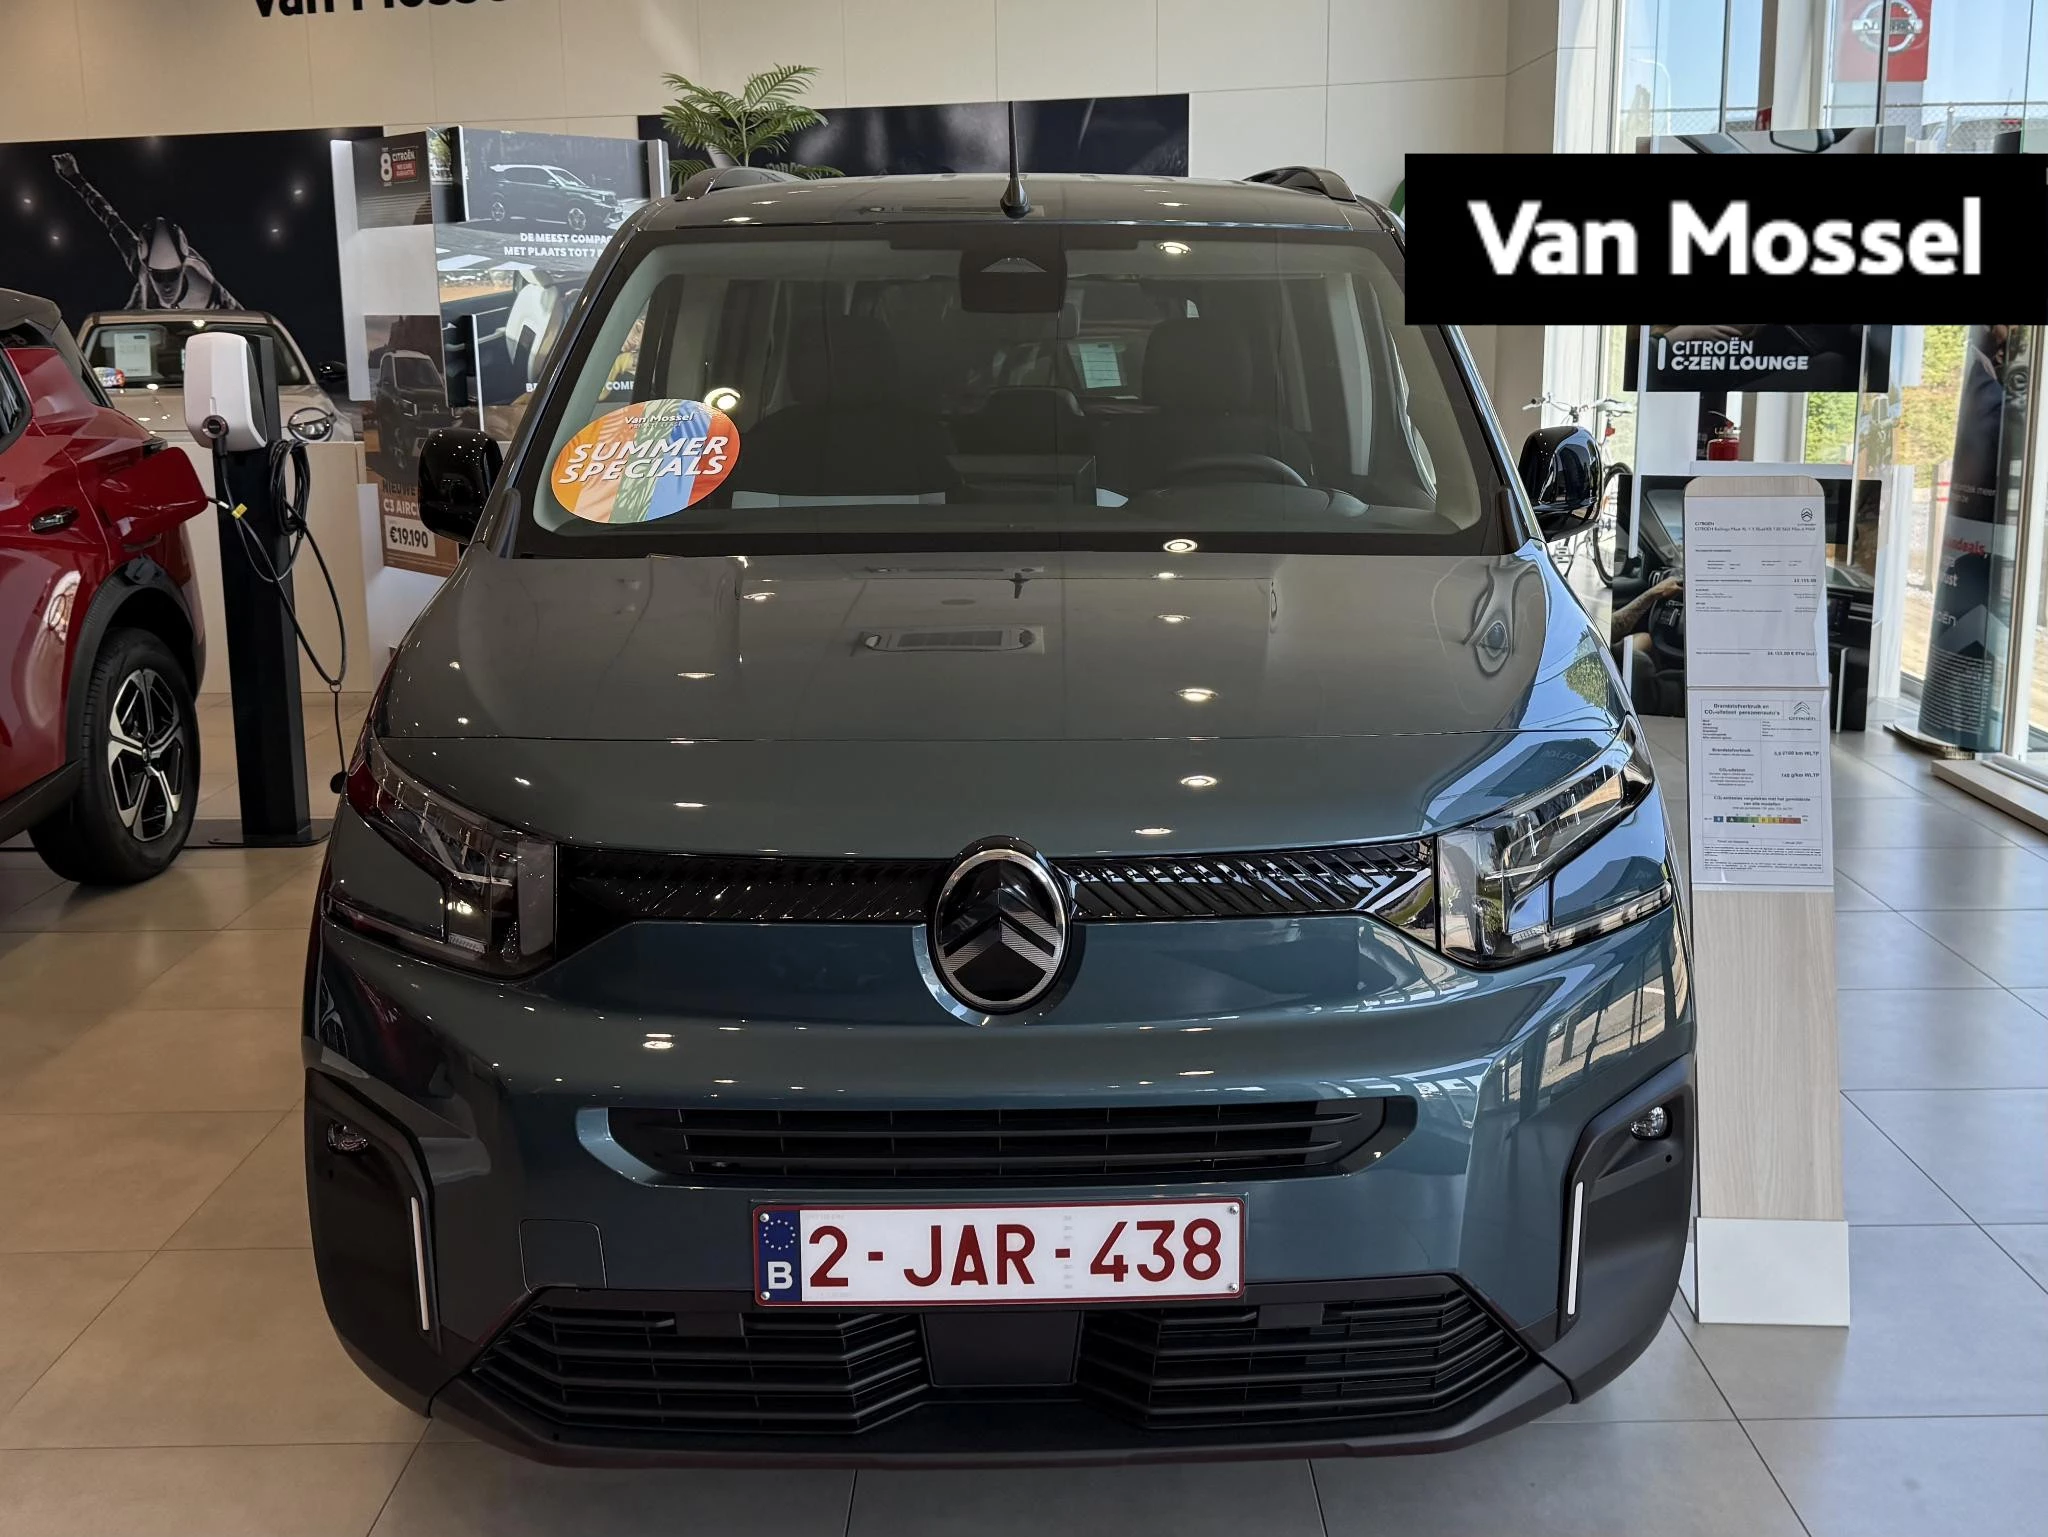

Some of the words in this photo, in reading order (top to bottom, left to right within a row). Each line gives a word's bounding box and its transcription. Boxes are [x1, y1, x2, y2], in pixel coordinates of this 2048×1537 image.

[380, 152, 393, 181] 8
[520, 233, 534, 242] DE
[535, 233, 569, 243] MEEST
[504, 246, 526, 256] MET
[528, 246, 566, 257] PLAATS
[568, 248, 588, 257] TOT
[588, 249, 595, 257] 7
[1672, 337, 1754, 355] CITROËN
[1671, 355, 1726, 371] C-ZEN
[1729, 355, 1809, 371] LOUNGE
[624, 415, 647, 425] Van
[650, 411, 694, 424] Mossel
[568, 436, 729, 464] SUMMER
[559, 455, 728, 484] SPECIALS
[383, 480, 416, 496] NIEUWE
[384, 498, 395, 512] C3
[389, 526, 429, 549] €19.190
[809, 1219, 1222, 1288] 2-JAR-438
[768, 1261, 793, 1290] B
